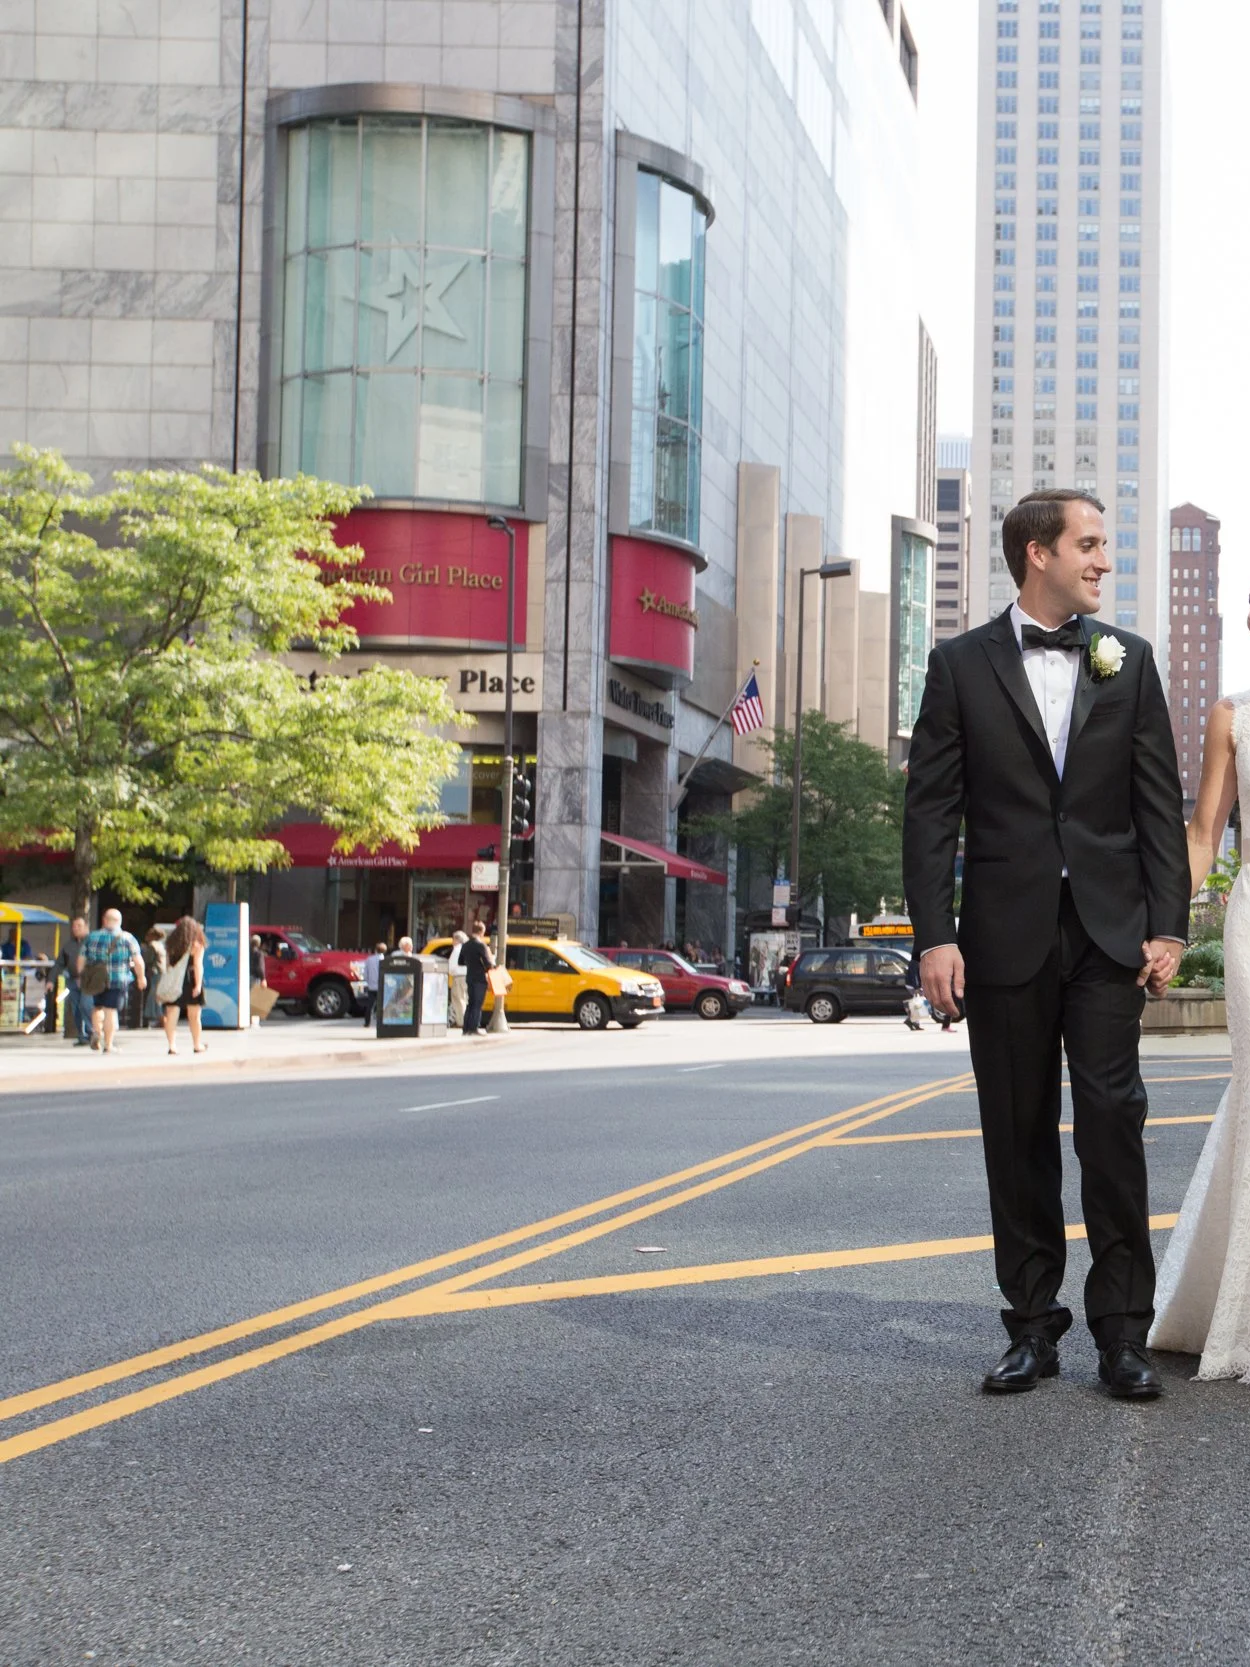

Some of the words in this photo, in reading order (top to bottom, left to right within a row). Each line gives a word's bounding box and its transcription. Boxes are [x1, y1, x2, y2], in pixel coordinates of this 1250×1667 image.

[317, 566, 392, 584] merican
[400, 562, 440, 585] Girl
[448, 566, 503, 590] Place
